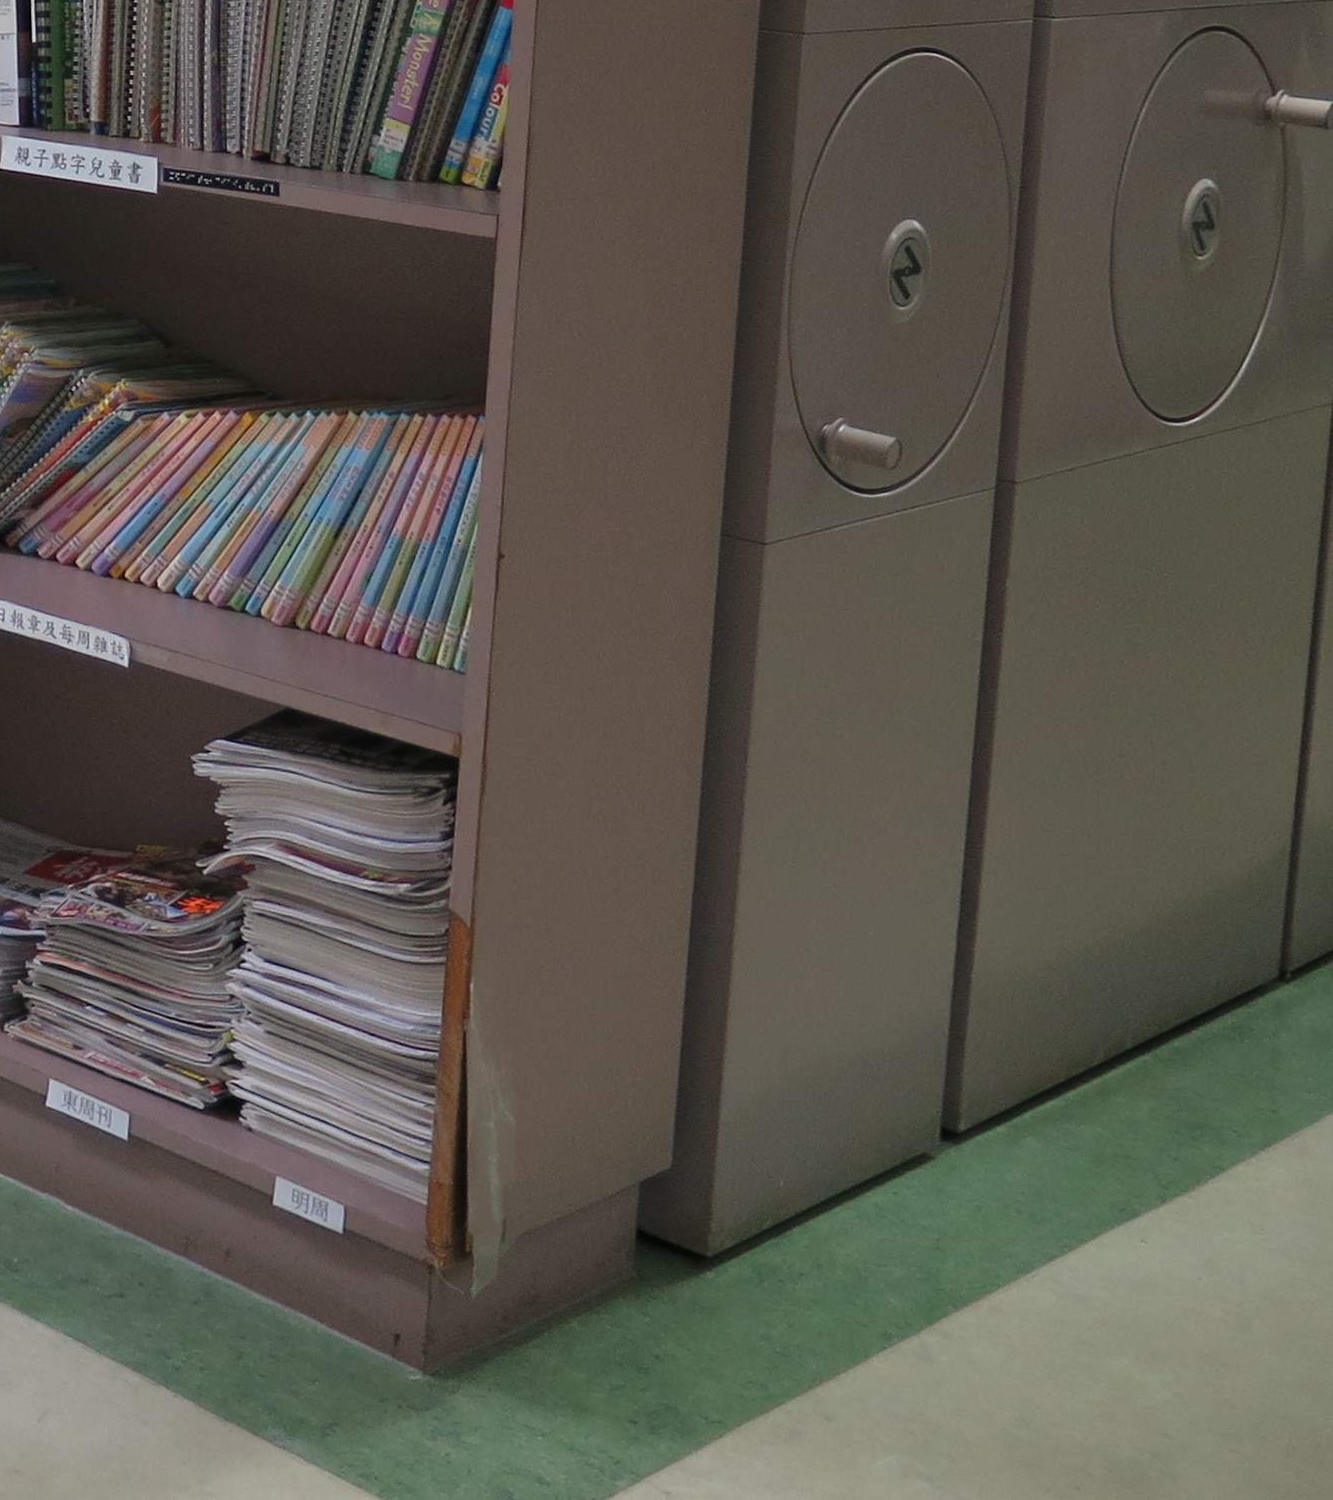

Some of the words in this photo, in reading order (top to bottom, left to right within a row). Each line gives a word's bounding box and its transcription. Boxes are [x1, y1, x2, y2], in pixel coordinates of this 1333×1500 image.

[397, 33, 432, 112] Monster!
[12, 143, 143, 185] 親子點字兒童書
[291, 1187, 329, 1224] 明周
